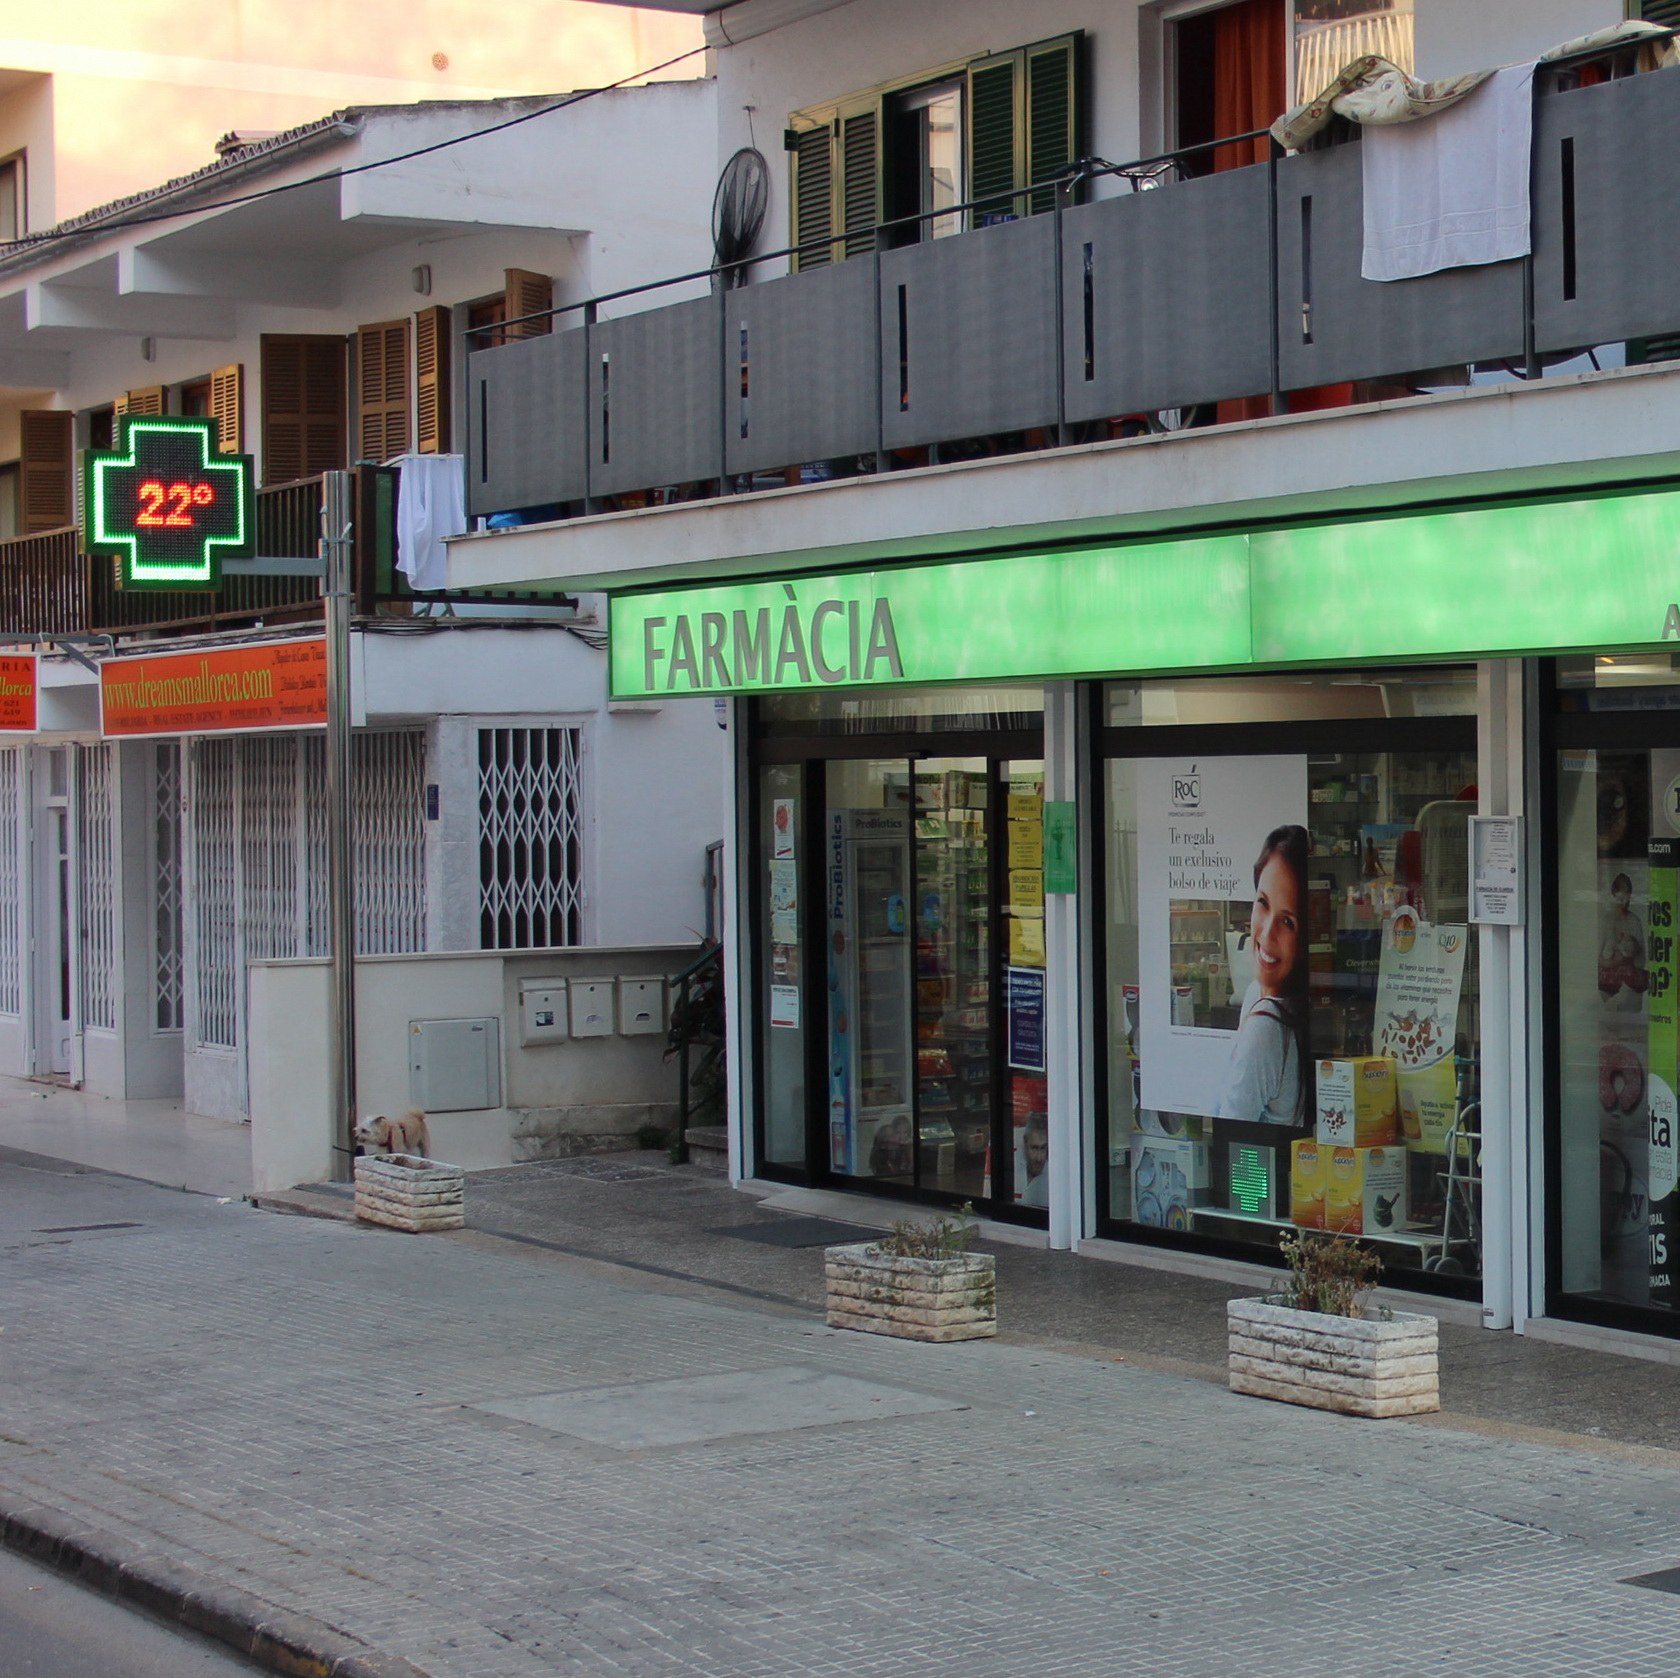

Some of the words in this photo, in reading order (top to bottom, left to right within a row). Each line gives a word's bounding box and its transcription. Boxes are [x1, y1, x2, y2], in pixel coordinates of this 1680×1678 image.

[644, 584, 904, 690] FARMÀCIA
[105, 660, 273, 710] www.dreamsmallorca.com
[1168, 827, 1180, 844] Te
[1184, 827, 1215, 850] regala
[832, 814, 843, 919] ProBiotics
[1169, 856, 1182, 867] un
[1185, 850, 1232, 867] exclusivo
[1169, 872, 1195, 889] bolso
[1199, 872, 1210, 889] de
